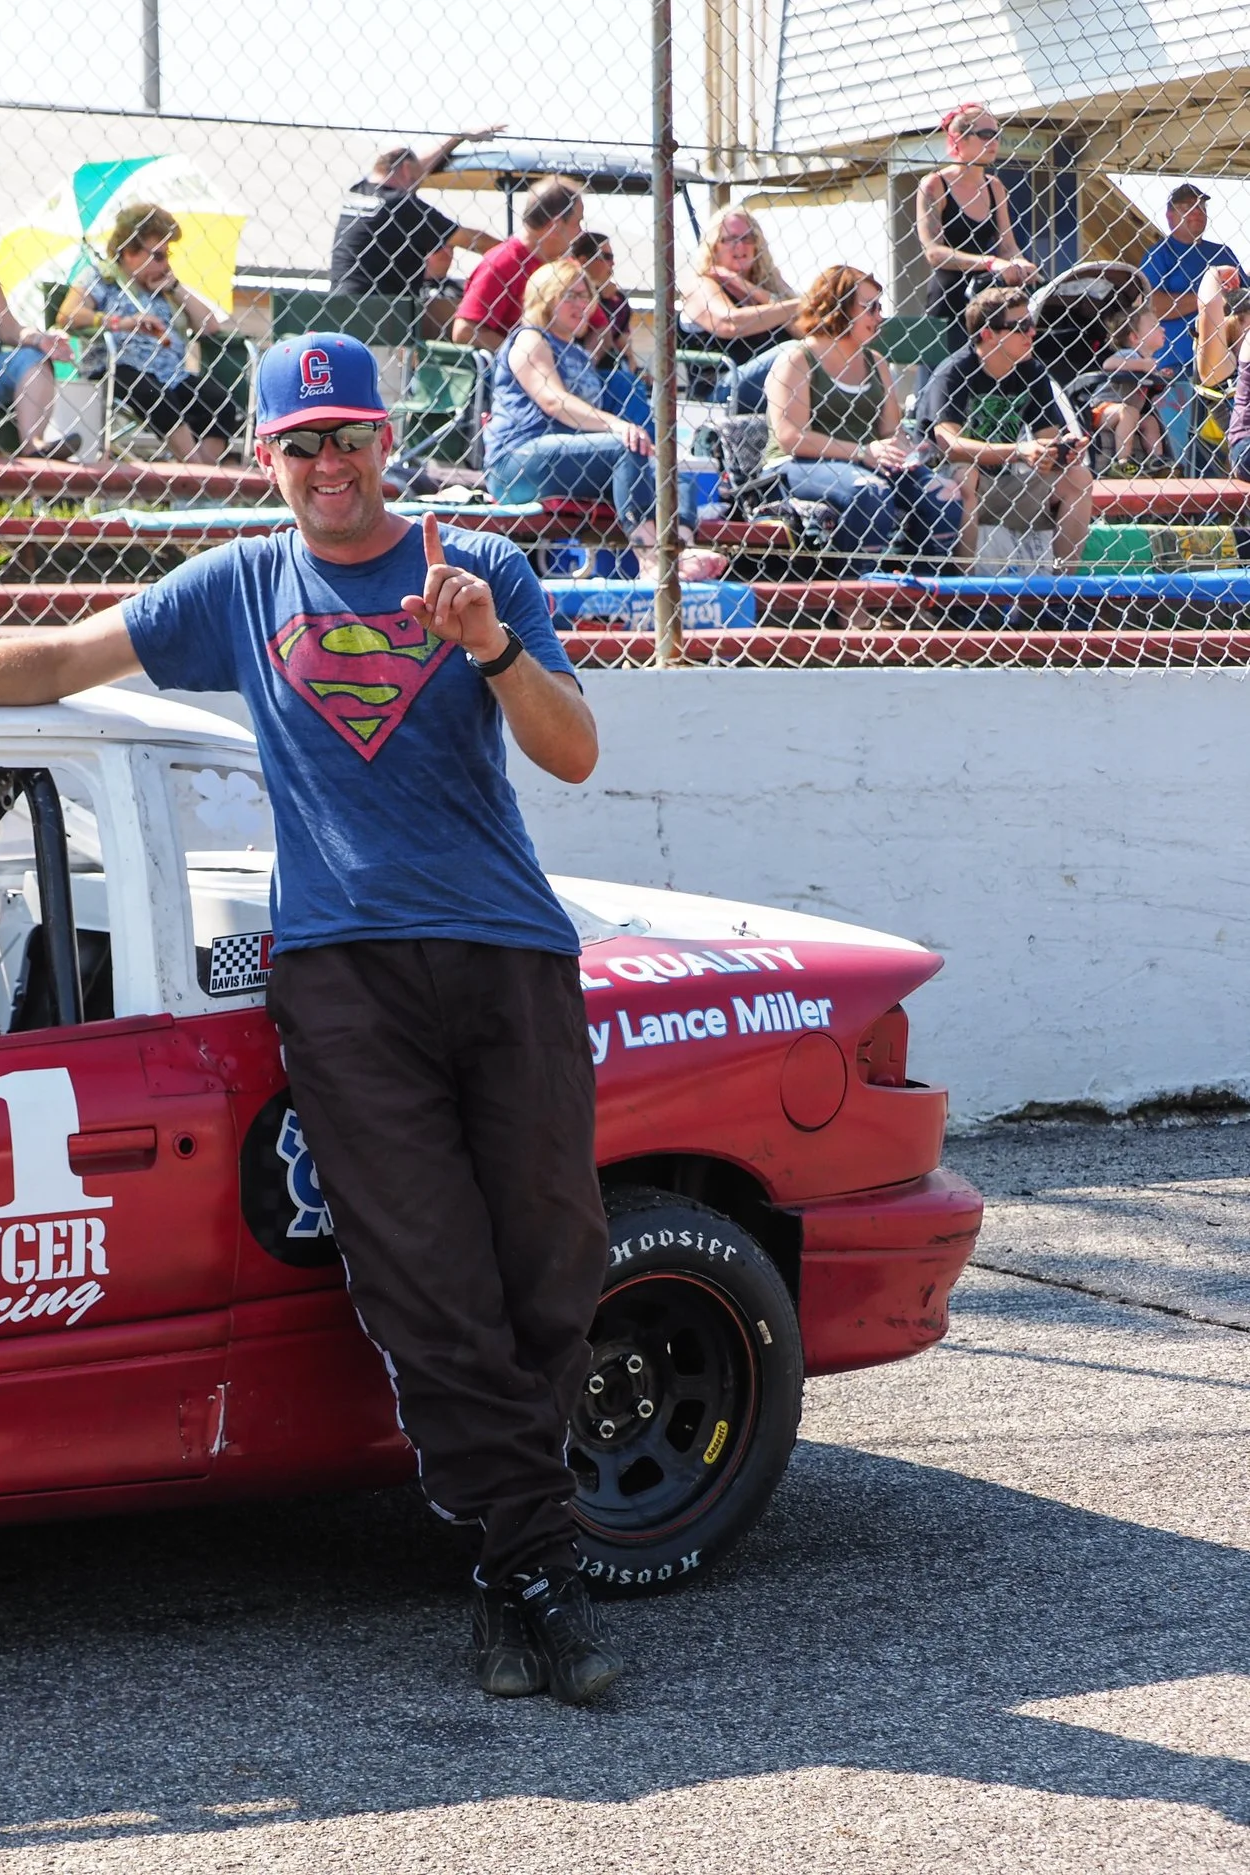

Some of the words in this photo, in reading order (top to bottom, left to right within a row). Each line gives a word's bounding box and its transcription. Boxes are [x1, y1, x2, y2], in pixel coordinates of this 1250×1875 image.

[299, 380, 334, 400] Tools
[211, 974, 240, 991] DAVIS
[605, 946, 804, 984] QUALITY
[616, 1006, 728, 1049] Lance
[730, 991, 834, 1035] Miller
[609, 1227, 739, 1268] Hoosier
[575, 1548, 703, 1585] Hoosier
